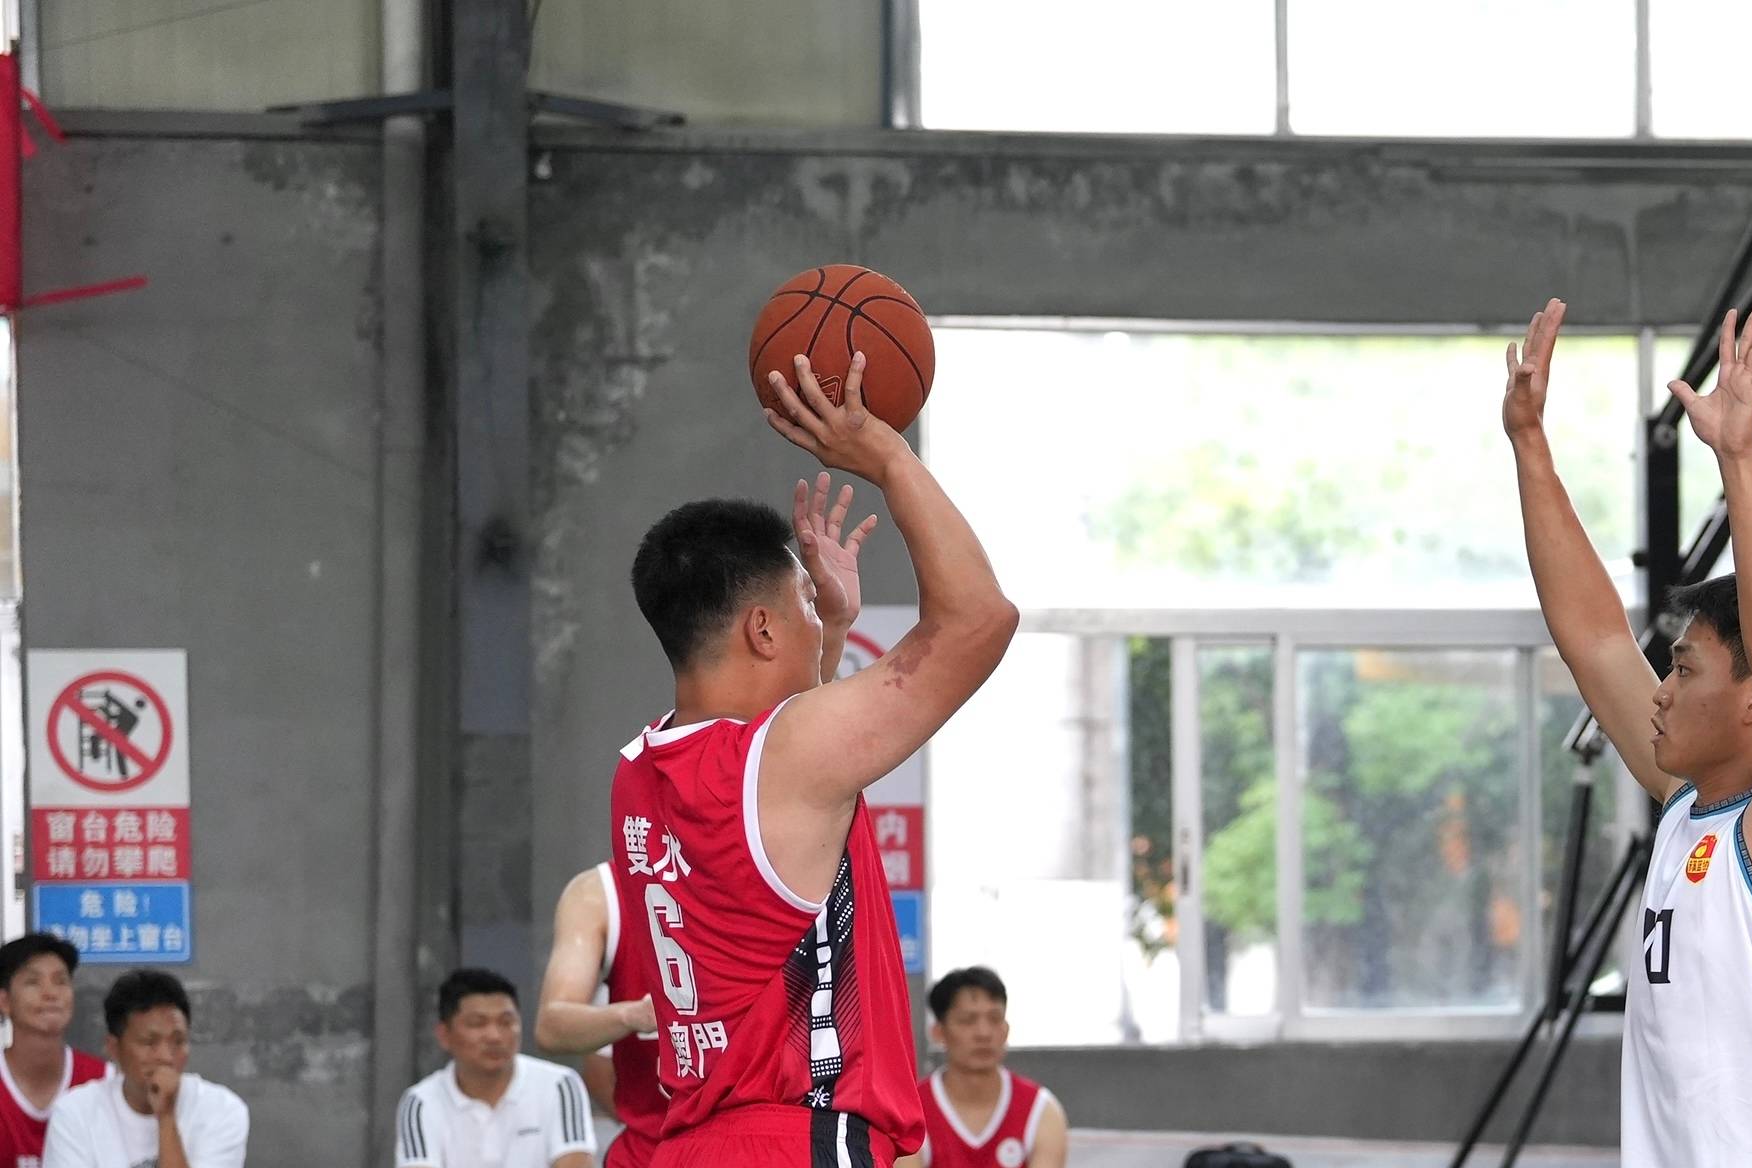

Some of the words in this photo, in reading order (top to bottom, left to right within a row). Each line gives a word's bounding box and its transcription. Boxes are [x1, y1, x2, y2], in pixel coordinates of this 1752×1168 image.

[47, 811, 177, 843] 窗台危险
[622, 815, 692, 882] 雙水
[47, 844, 177, 878] 请勿攀爬
[645, 883, 699, 1016] 6
